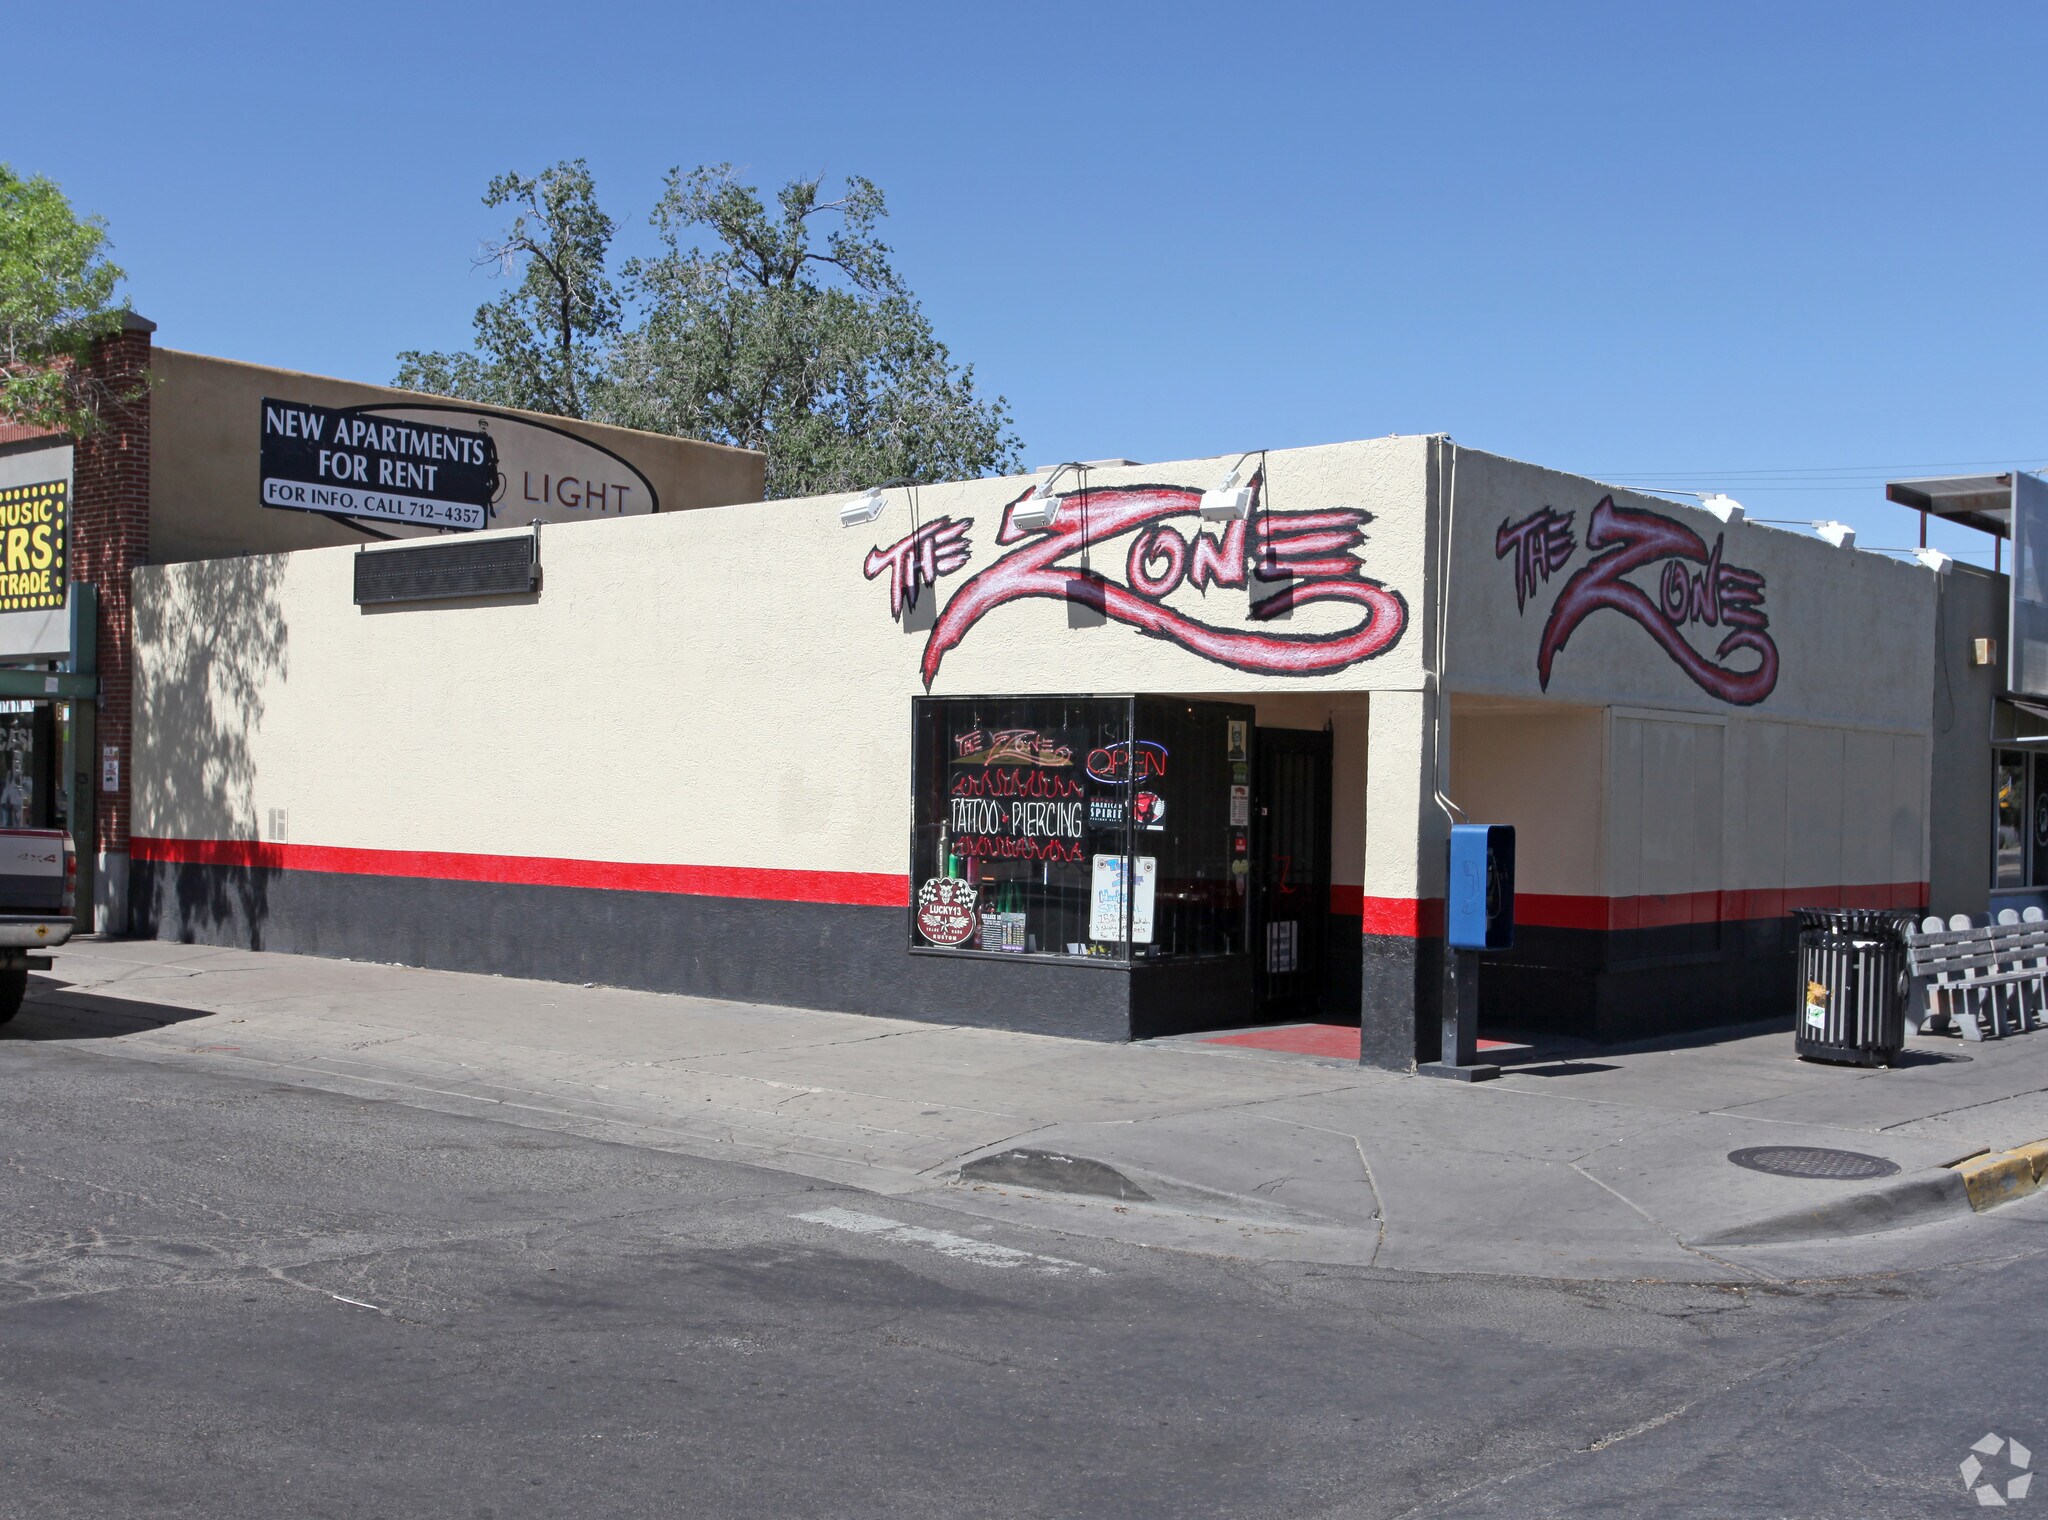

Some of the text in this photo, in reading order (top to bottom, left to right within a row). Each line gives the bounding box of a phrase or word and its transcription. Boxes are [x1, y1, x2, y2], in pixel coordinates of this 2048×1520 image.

[266, 406, 485, 466] NEW APARTMENTS
[319, 450, 438, 492] FOR RENT
[269, 483, 304, 503] FOR
[311, 489, 358, 509] INFO.
[364, 496, 405, 515] CALL
[524, 471, 630, 513] LIGHT
[863, 462, 1409, 695] THE ZONE
[1495, 494, 1781, 706] THE ZONE
[1087, 748, 1166, 777] OPEN
[951, 797, 1082, 838] TATTOO PIERCING
[1090, 808, 1122, 819] SPIRIT
[1097, 904, 1142, 913] SPEAL
